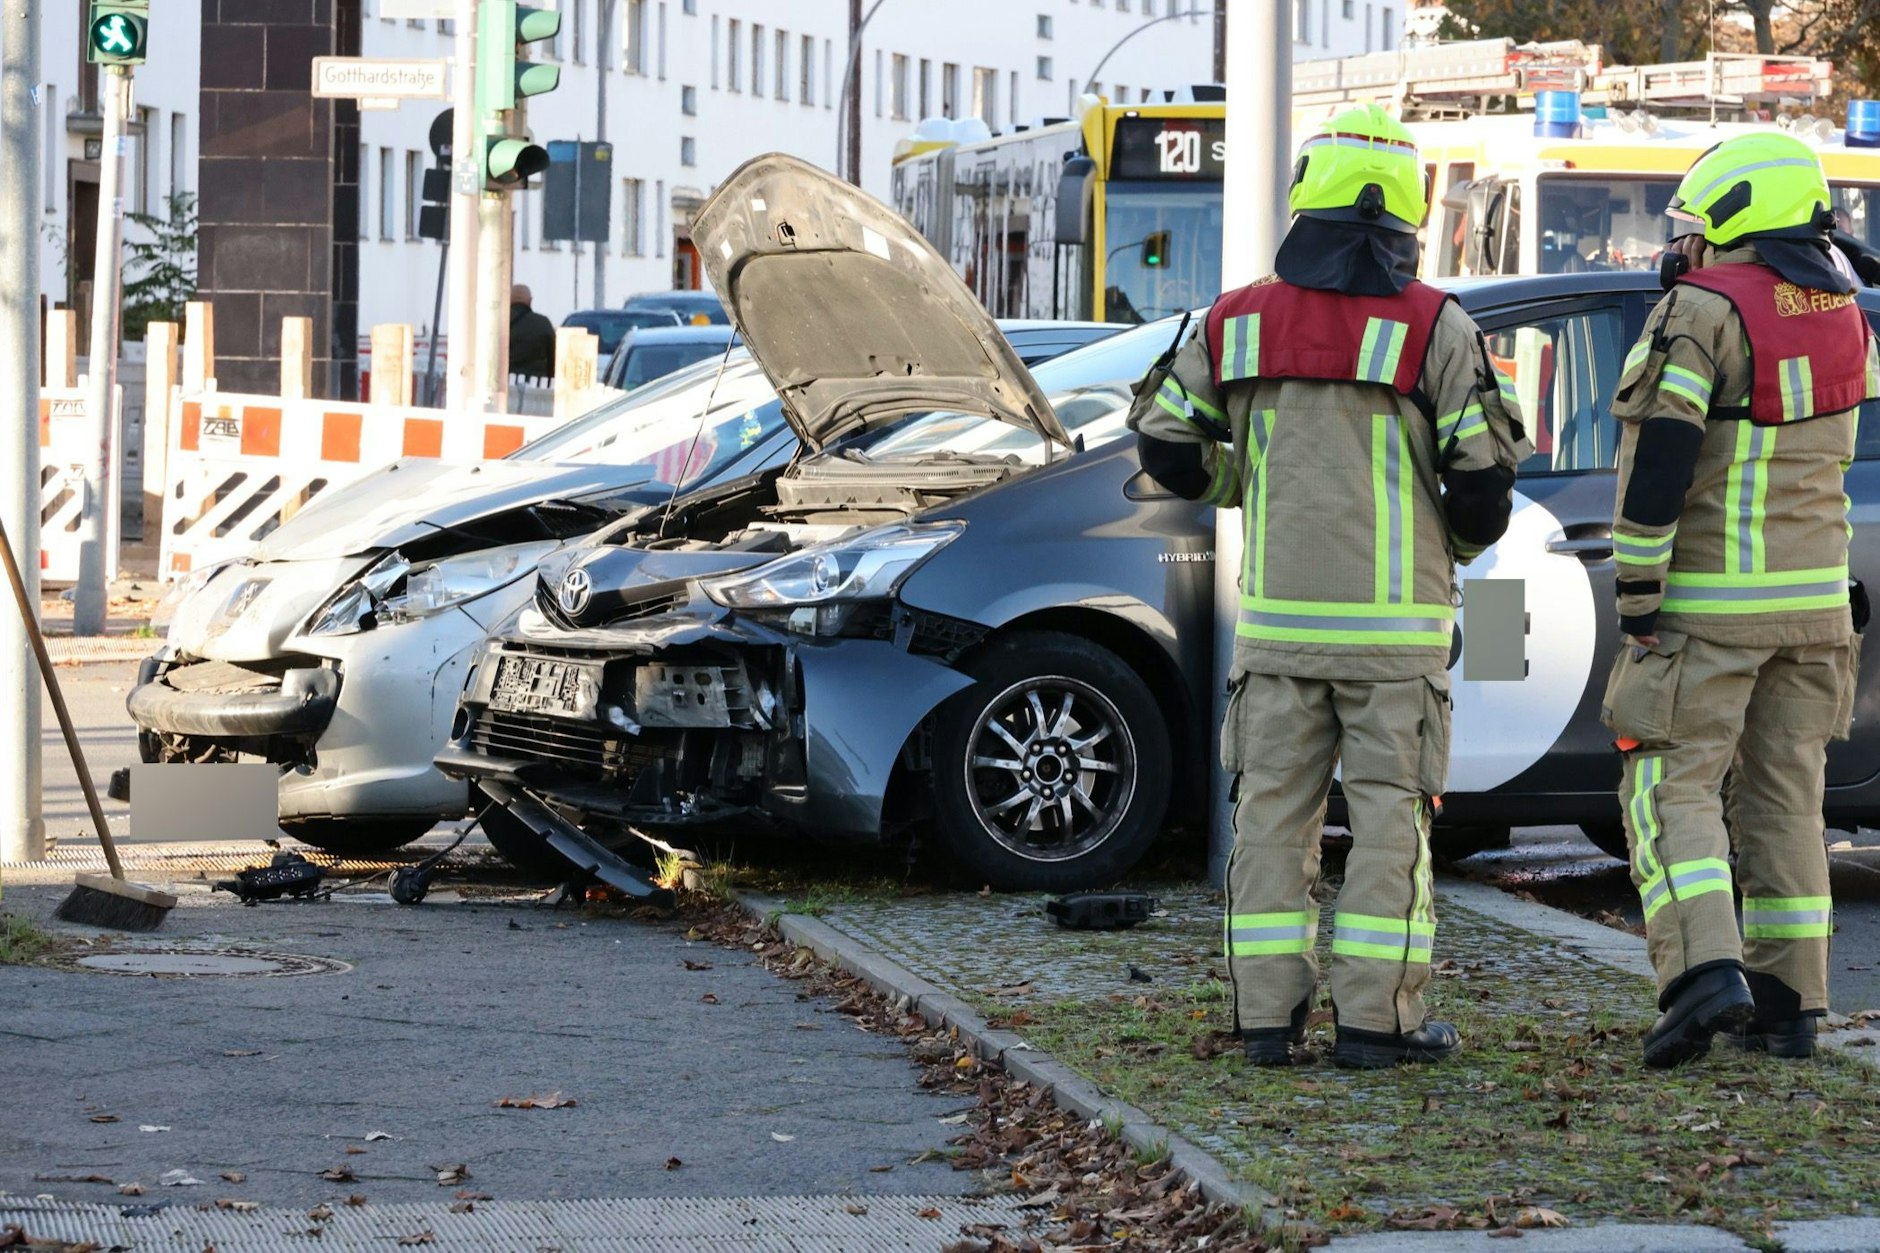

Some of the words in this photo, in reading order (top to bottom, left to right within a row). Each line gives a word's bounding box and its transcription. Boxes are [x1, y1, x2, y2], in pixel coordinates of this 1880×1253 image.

[325, 66, 435, 89] Gotthardstraße
[1154, 130, 1200, 173] 120
[1158, 552, 1207, 562] HYBRID
